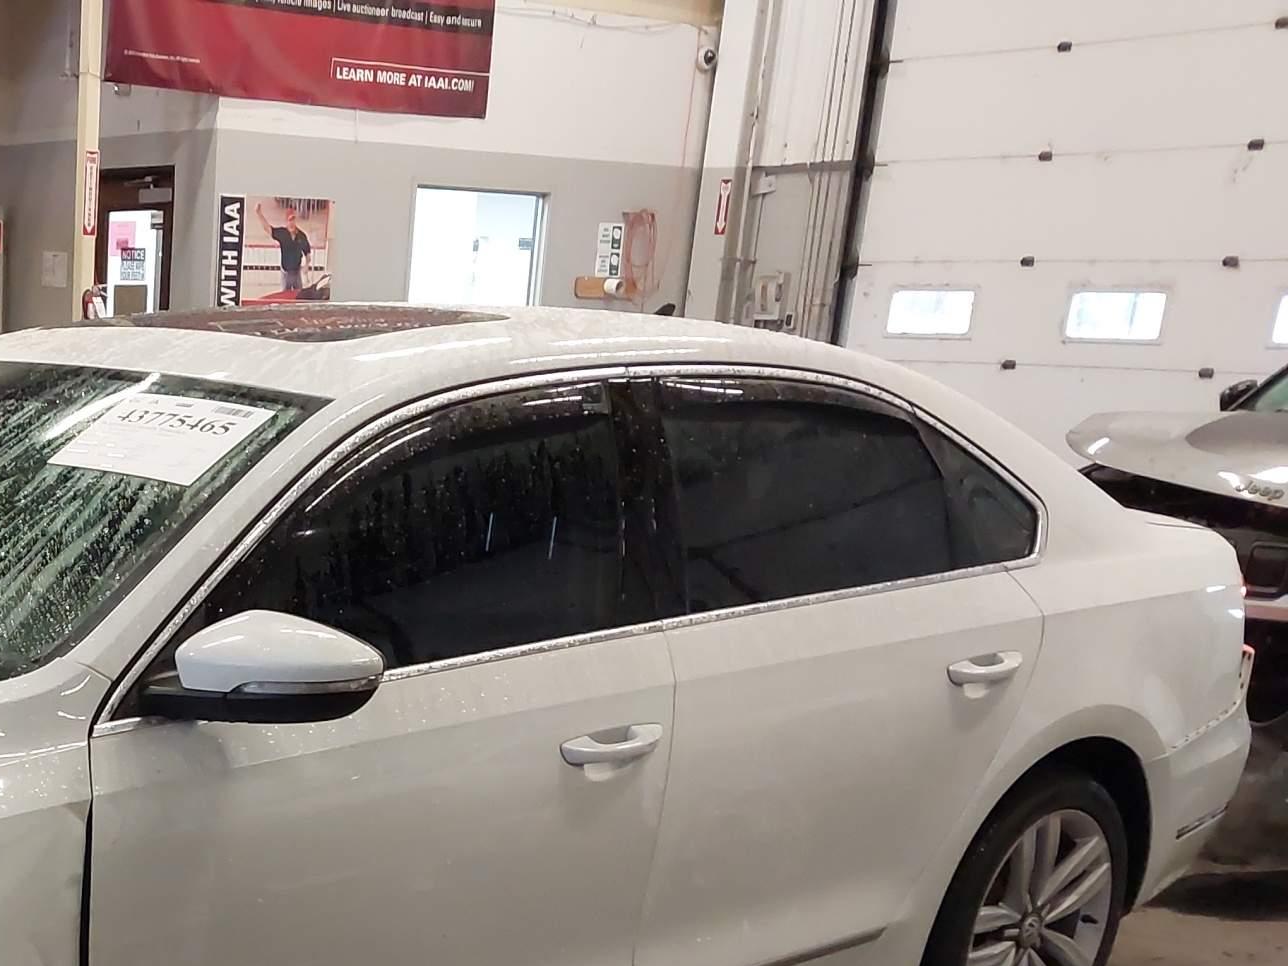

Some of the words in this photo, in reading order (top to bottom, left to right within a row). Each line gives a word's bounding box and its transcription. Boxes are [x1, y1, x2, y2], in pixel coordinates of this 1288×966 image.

[337, 0, 351, 12] Live
[391, 6, 424, 22] broadcast
[429, 11, 445, 27] Easy
[445, 14, 461, 26] and
[336, 66, 374, 82] LEARN
[376, 70, 406, 85] MORE
[408, 74, 422, 87] AT
[223, 202, 241, 243] IAA
[219, 249, 238, 306] WITH
[117, 409, 237, 436] 43775465
